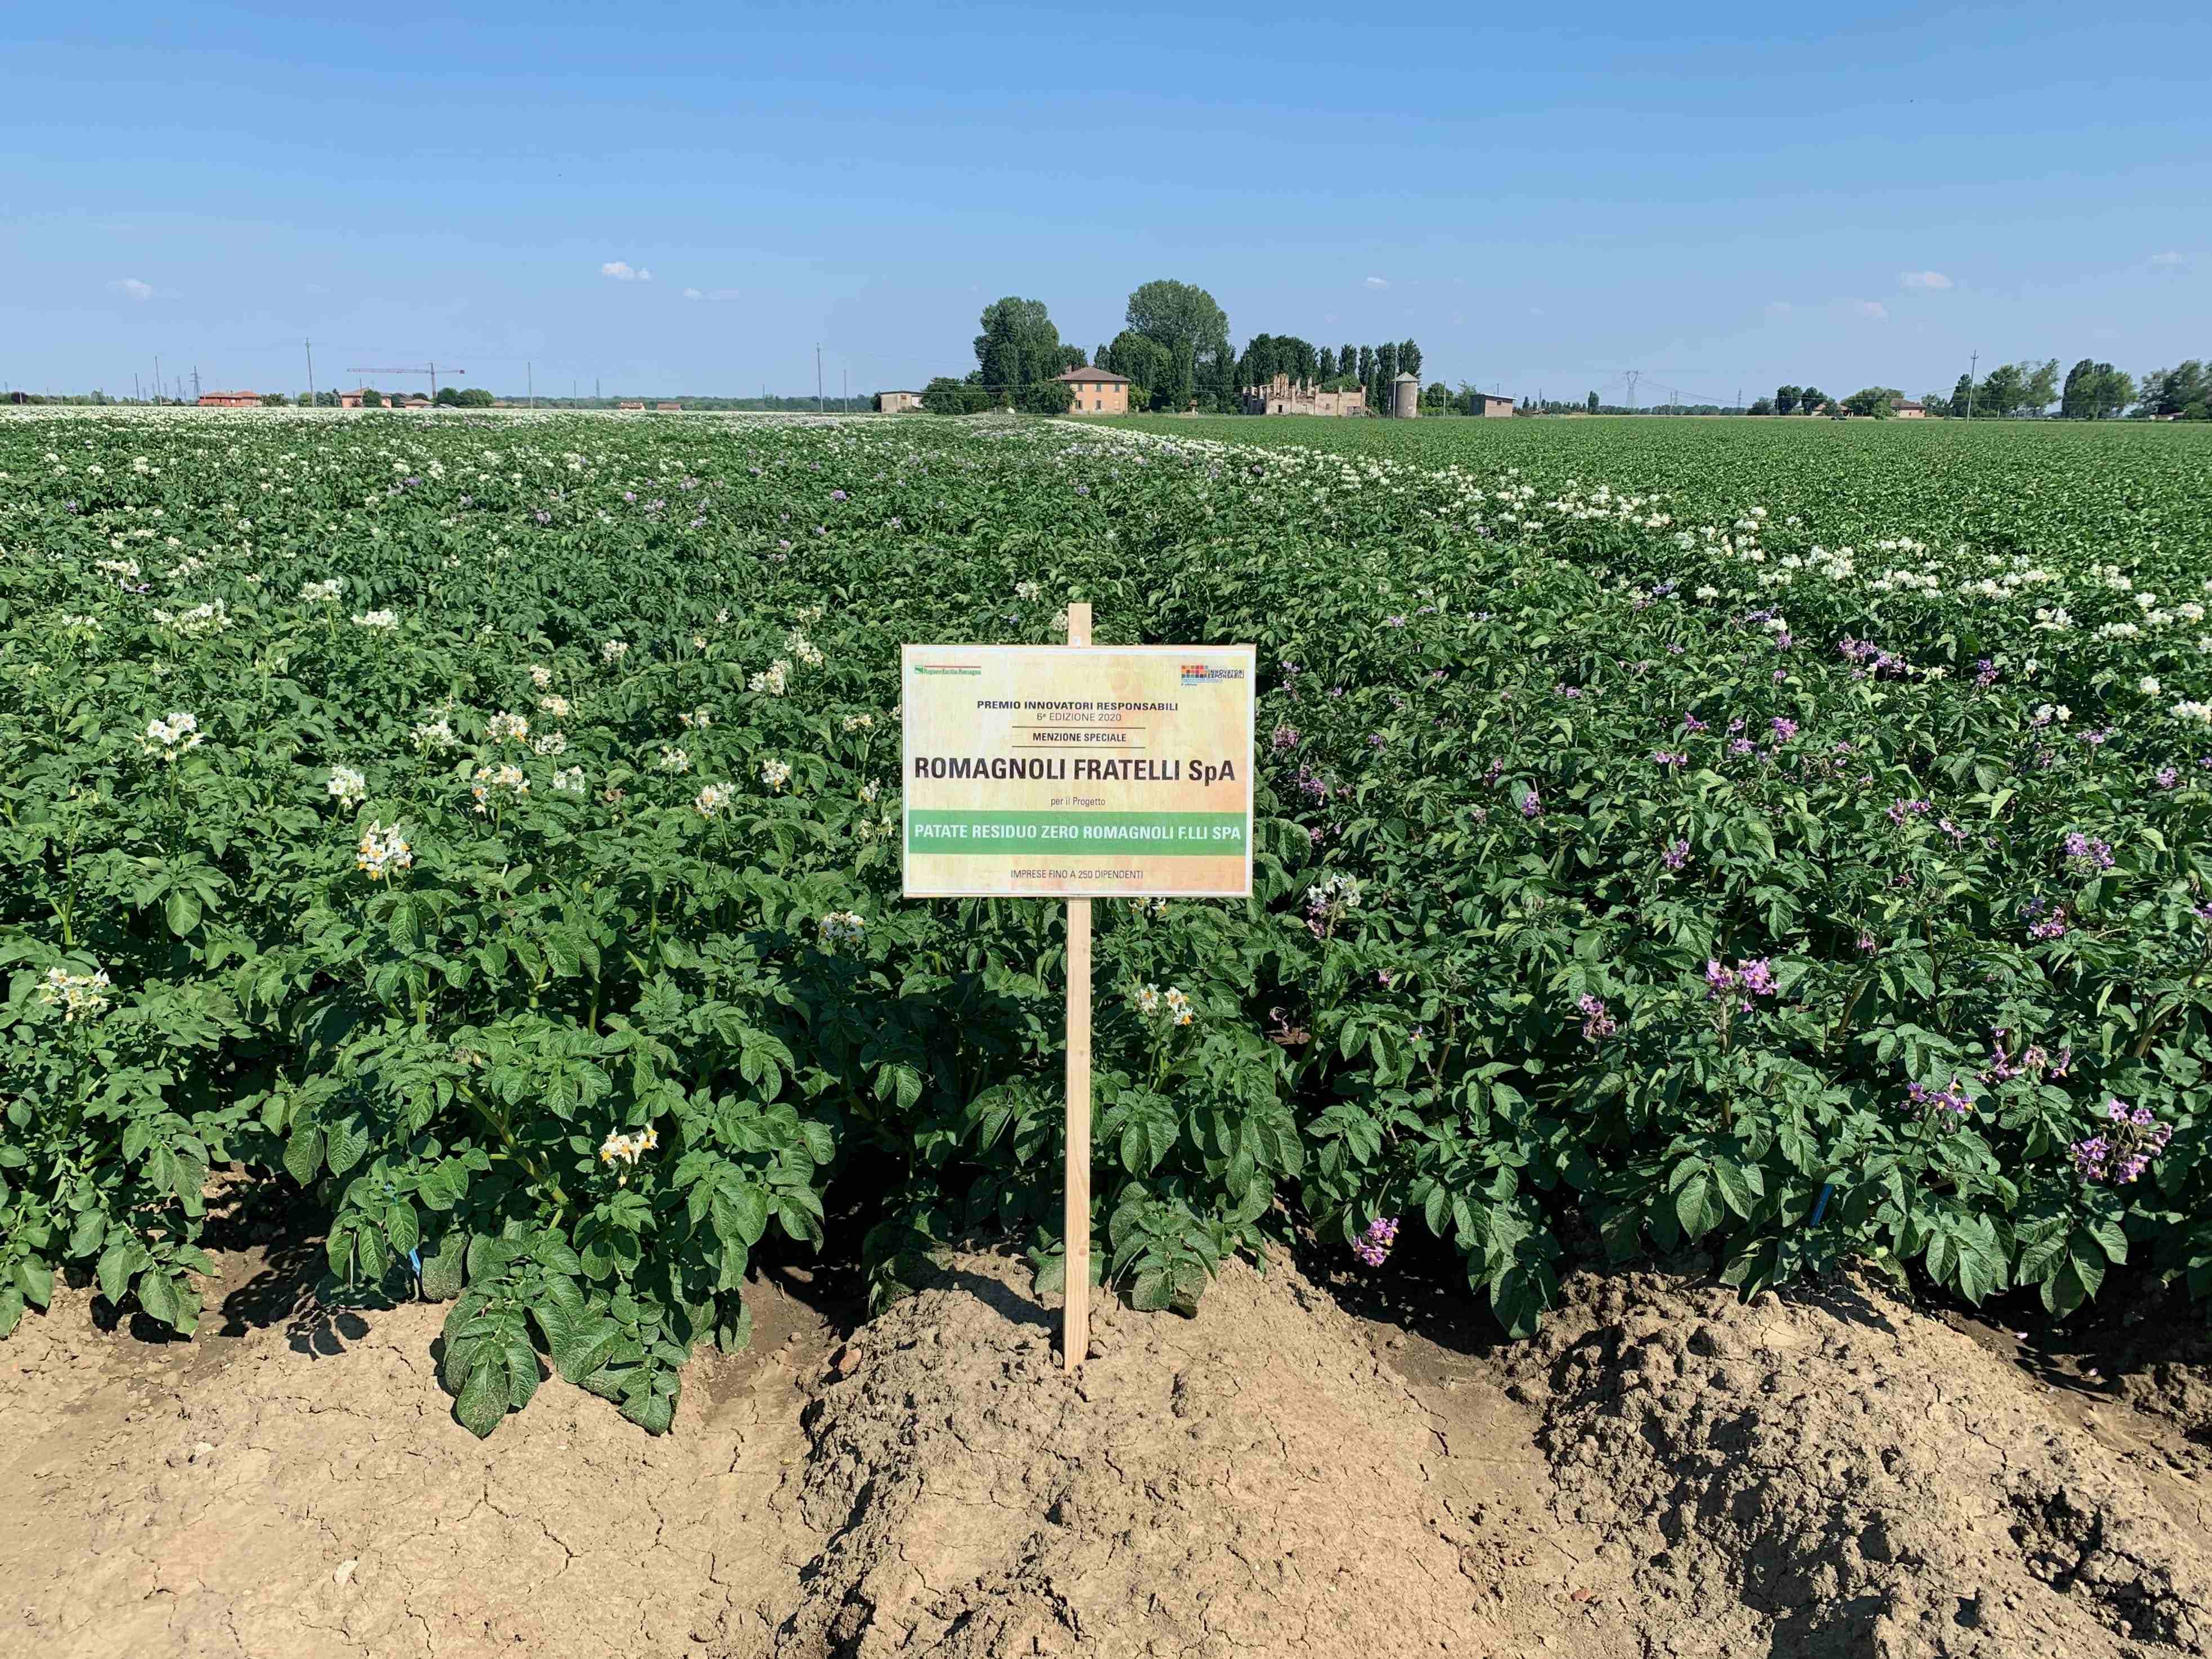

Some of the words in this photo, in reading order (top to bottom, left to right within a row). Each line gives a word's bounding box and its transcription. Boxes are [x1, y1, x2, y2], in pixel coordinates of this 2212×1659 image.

[977, 700, 1021, 709] PREMIO
[1024, 701, 1093, 710] INNOVATORI
[1097, 702, 1178, 711] RESPONSABILI
[1049, 712, 1096, 721] EDIZIONE
[1098, 713, 1121, 721] 2020
[1033, 732, 1082, 742] MENZIONE
[1084, 733, 1127, 742] SPECIALE
[915, 757, 1065, 780] ROMAGNOLI
[1074, 759, 1179, 781] FRATELLI
[1188, 760, 1235, 786] SpA
[1051, 798, 1064, 807] per
[1066, 797, 1070, 806] il
[1073, 797, 1105, 807] Progetto
[914, 824, 967, 838] PATATE
[972, 825, 1036, 839] RESIDUO
[1040, 826, 1078, 839] ZERO
[1083, 826, 1174, 839] ROMAGNOLI
[1178, 827, 1208, 840] F.LLI
[1213, 827, 1241, 840] SPA
[1011, 869, 1047, 878] IMPRESE
[1049, 870, 1067, 878] FINO
[1069, 870, 1076, 878] A
[1078, 870, 1093, 879] 250
[1095, 870, 1143, 879] DIPENDENTI
